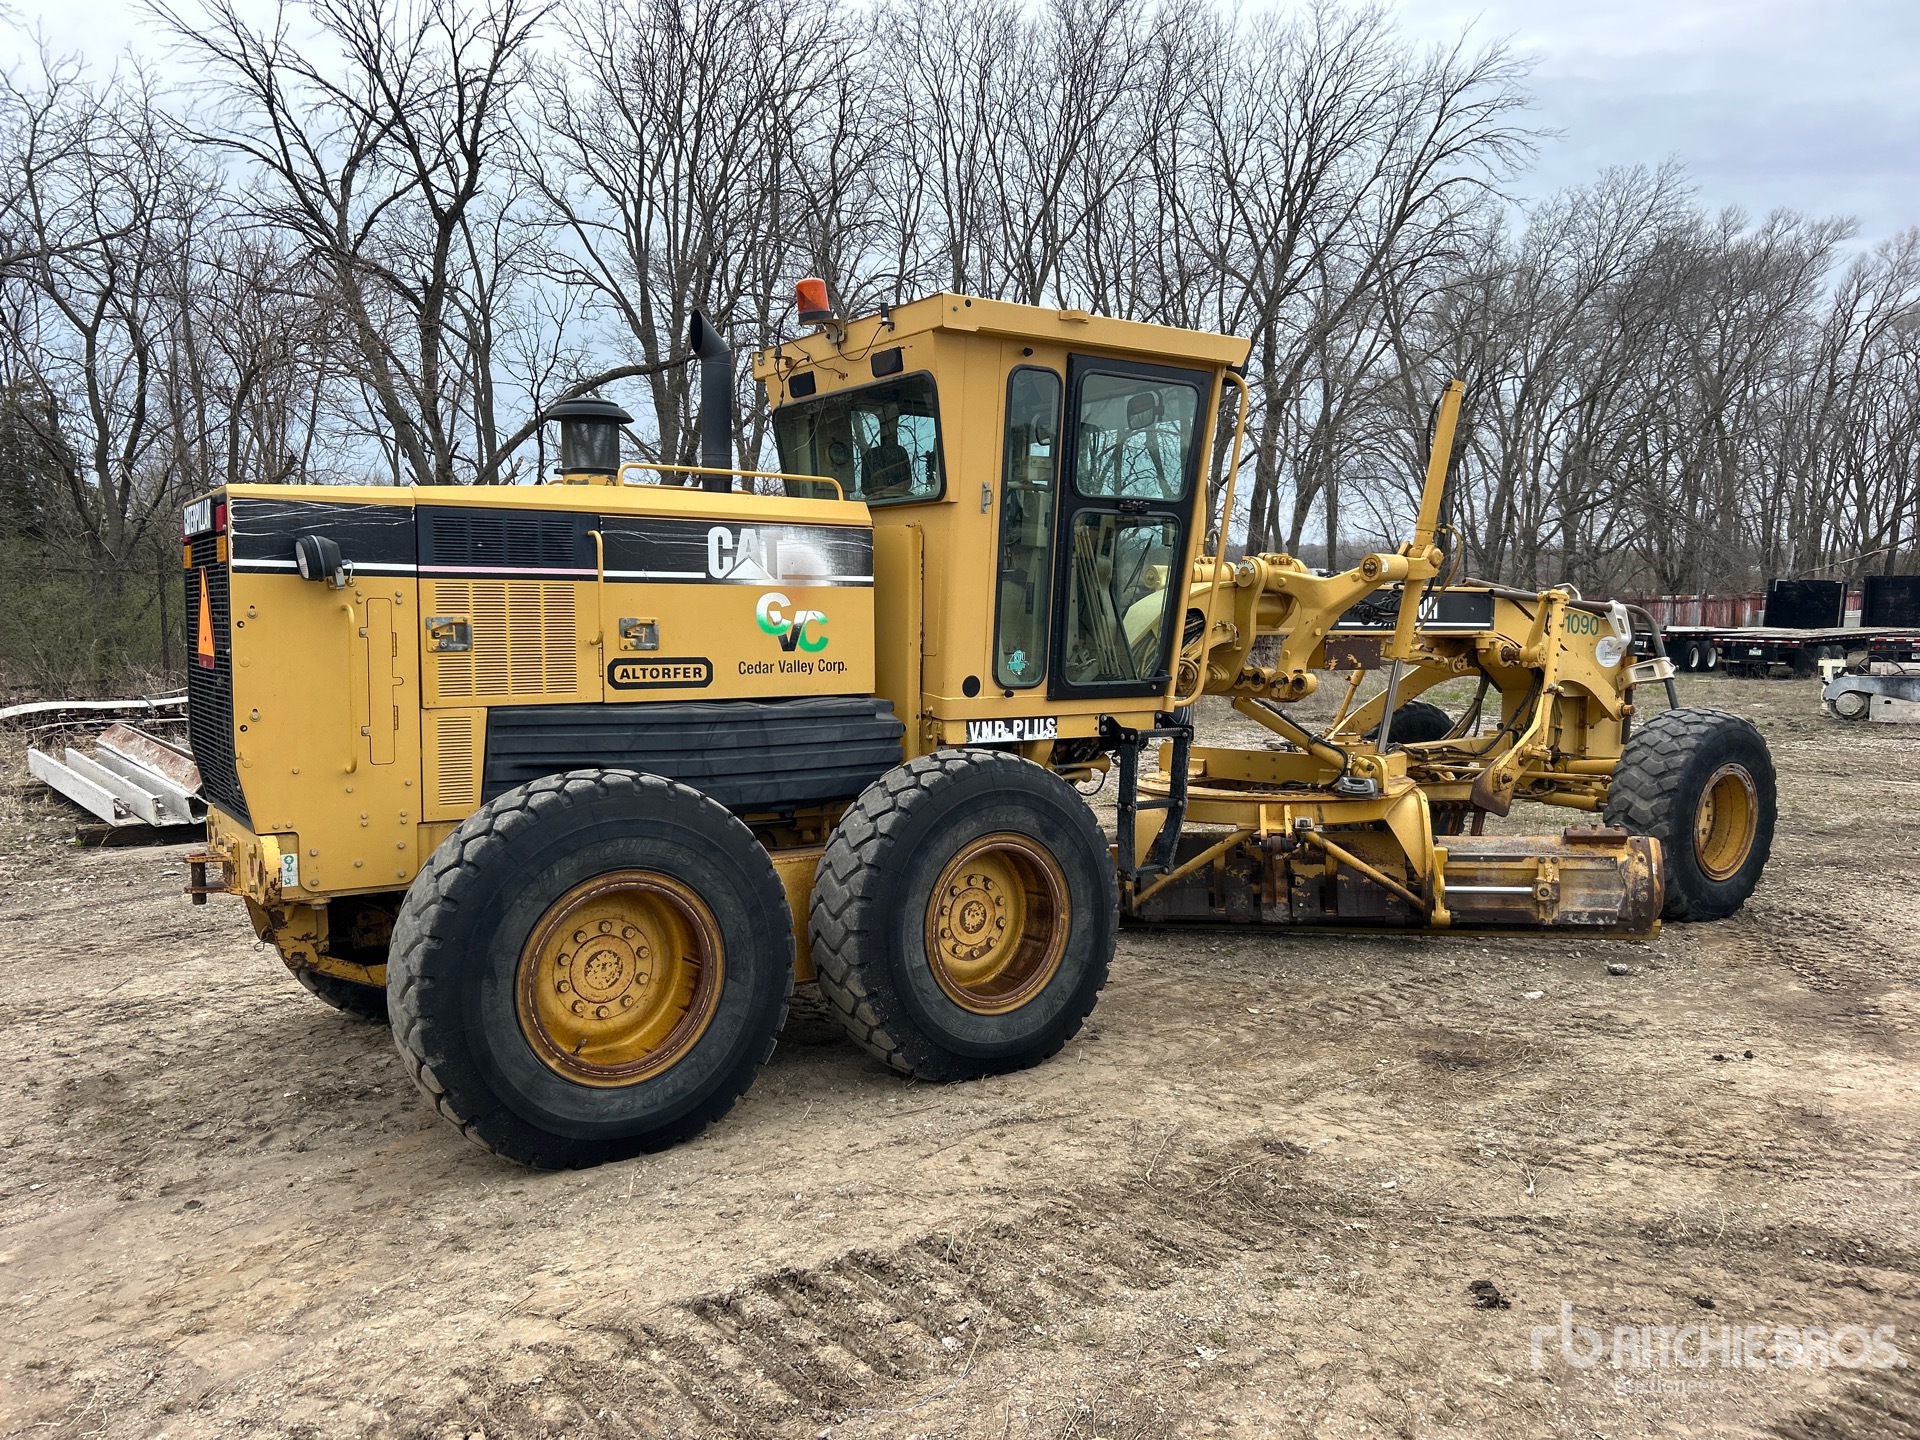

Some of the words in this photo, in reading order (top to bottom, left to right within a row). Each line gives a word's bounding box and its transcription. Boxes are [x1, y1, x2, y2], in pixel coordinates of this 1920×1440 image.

[707, 526, 784, 580] CAT
[755, 592, 829, 653] CVC
[1565, 614, 1600, 636] 1090
[620, 667, 702, 680] ALTORFER
[738, 661, 775, 675] Cedar
[778, 660, 814, 675] Valley
[817, 658, 848, 674] Corp.
[1012, 717, 1056, 740] PLUS
